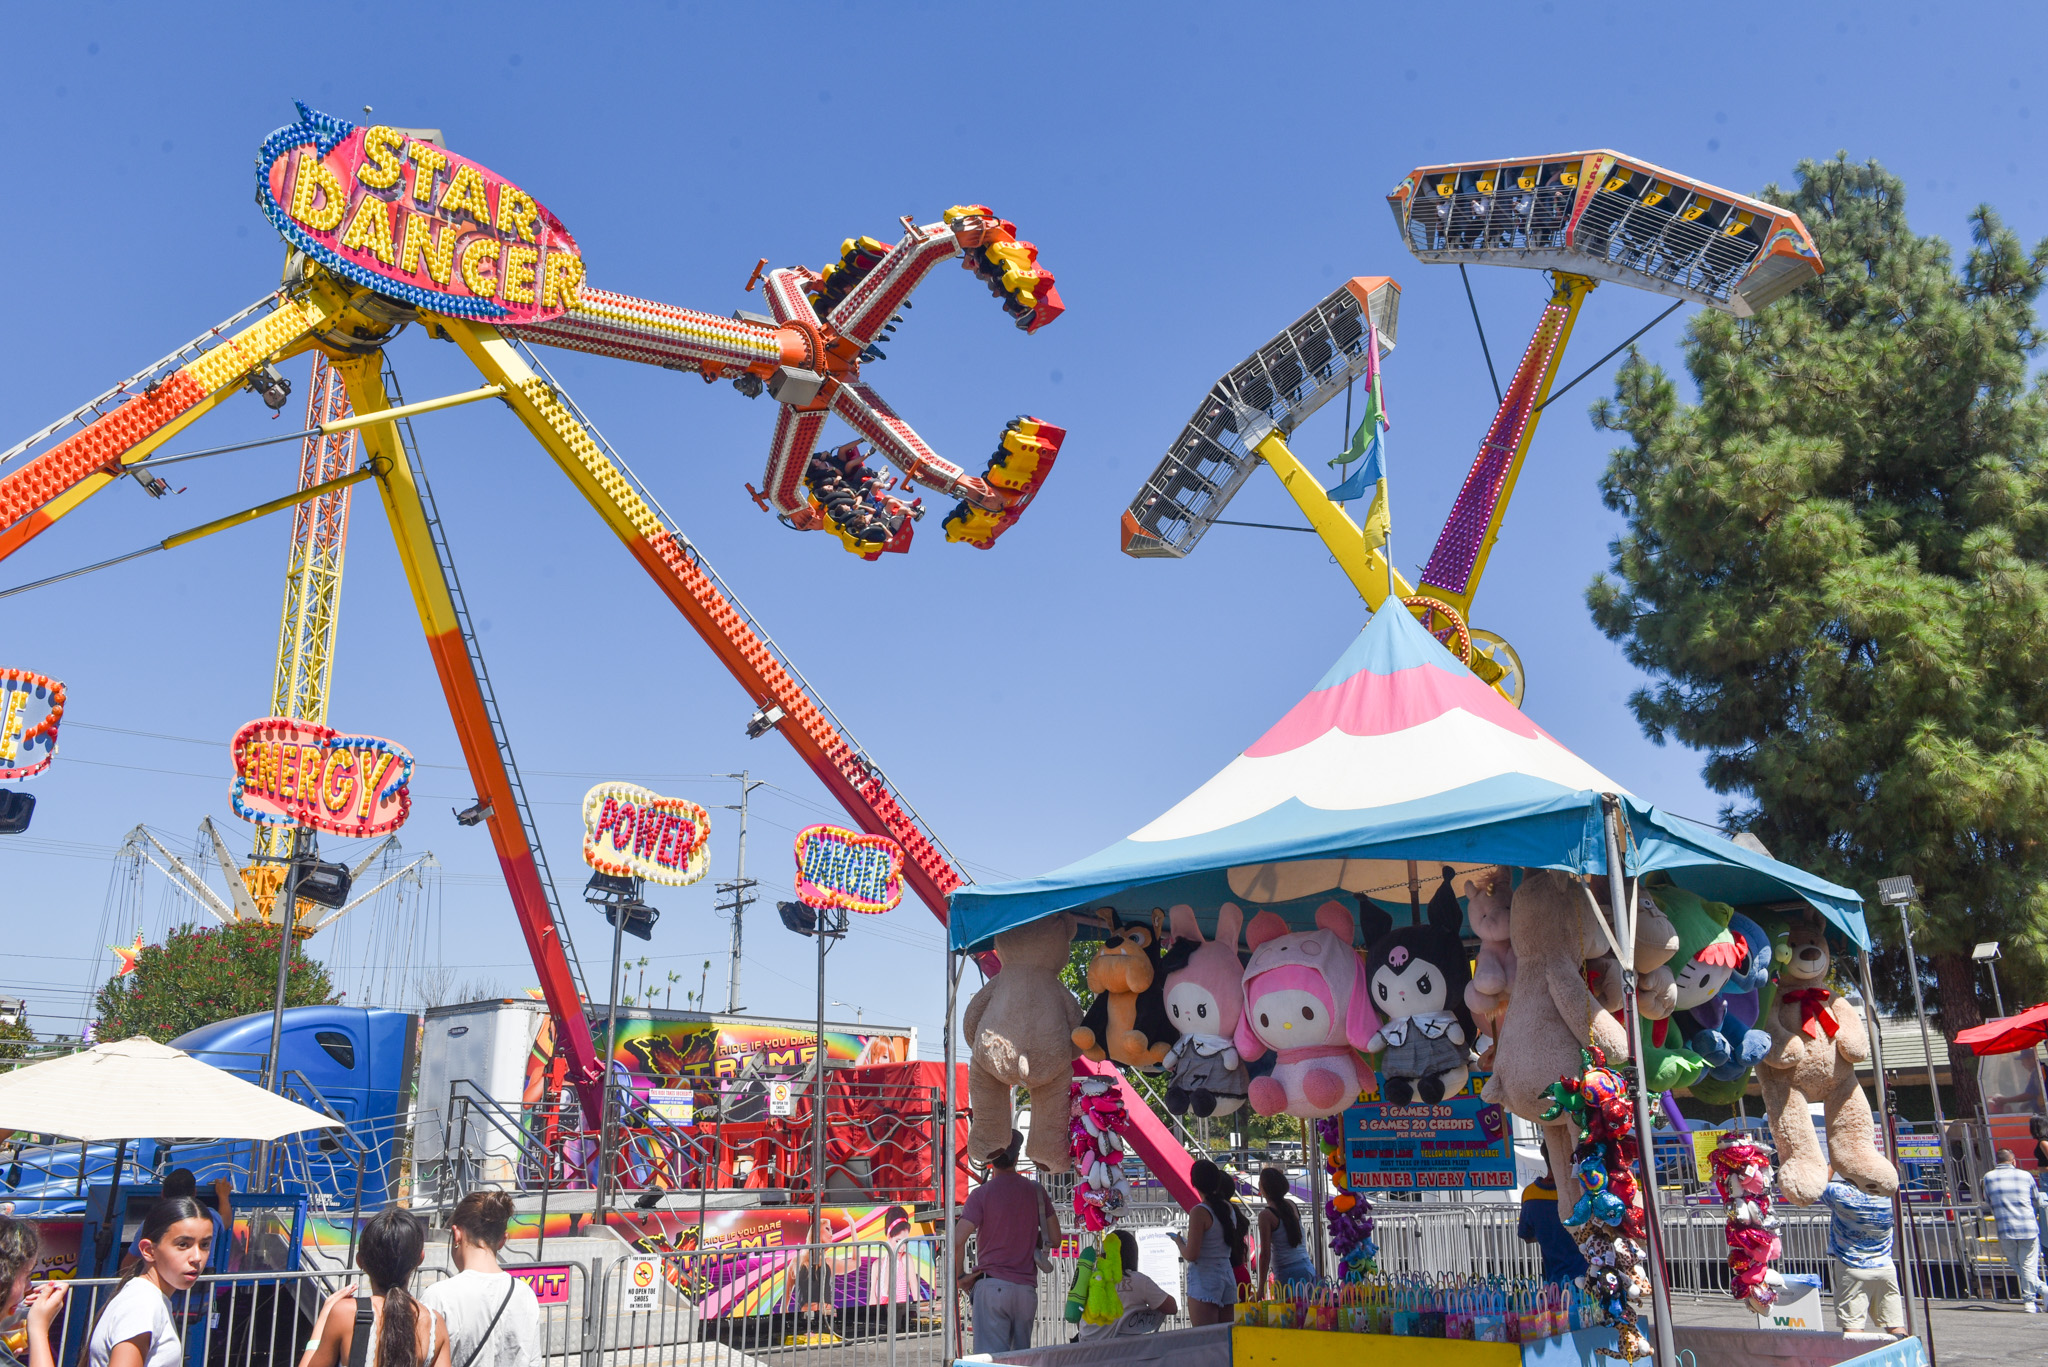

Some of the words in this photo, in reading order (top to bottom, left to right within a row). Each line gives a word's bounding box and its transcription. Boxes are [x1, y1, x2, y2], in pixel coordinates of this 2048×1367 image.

[357, 124, 539, 244] STAR
[1570, 155, 1605, 229] KAMIKAZE
[245, 740, 395, 820] ENERGY
[594, 796, 696, 873] POWER
[802, 836, 891, 904] DANGER
[719, 1043, 748, 1057] RIDE
[750, 1042, 763, 1054] IF
[764, 1038, 788, 1050] YOU
[1380, 1106, 1388, 1117] 3
[1389, 1106, 1430, 1117] GAMES
[1432, 1105, 1452, 1117] $10
[1360, 1120, 1368, 1130] 3
[1369, 1119, 1410, 1130] GAMES
[1411, 1120, 1427, 1130] 20
[1428, 1119, 1475, 1130] CREDITS
[1421, 1149, 1443, 1158] YELLOW
[1351, 1171, 1413, 1187] WINNER
[1416, 1171, 1466, 1187] EVERY
[1469, 1171, 1513, 1187] TIME!
[704, 1234, 726, 1246] RIDE
[727, 1232, 736, 1242] IF
[737, 1227, 756, 1238] YOU
[758, 1220, 782, 1233] DARE
[42, 1252, 76, 1267] YOU
[1773, 1317, 1806, 1327] WM
